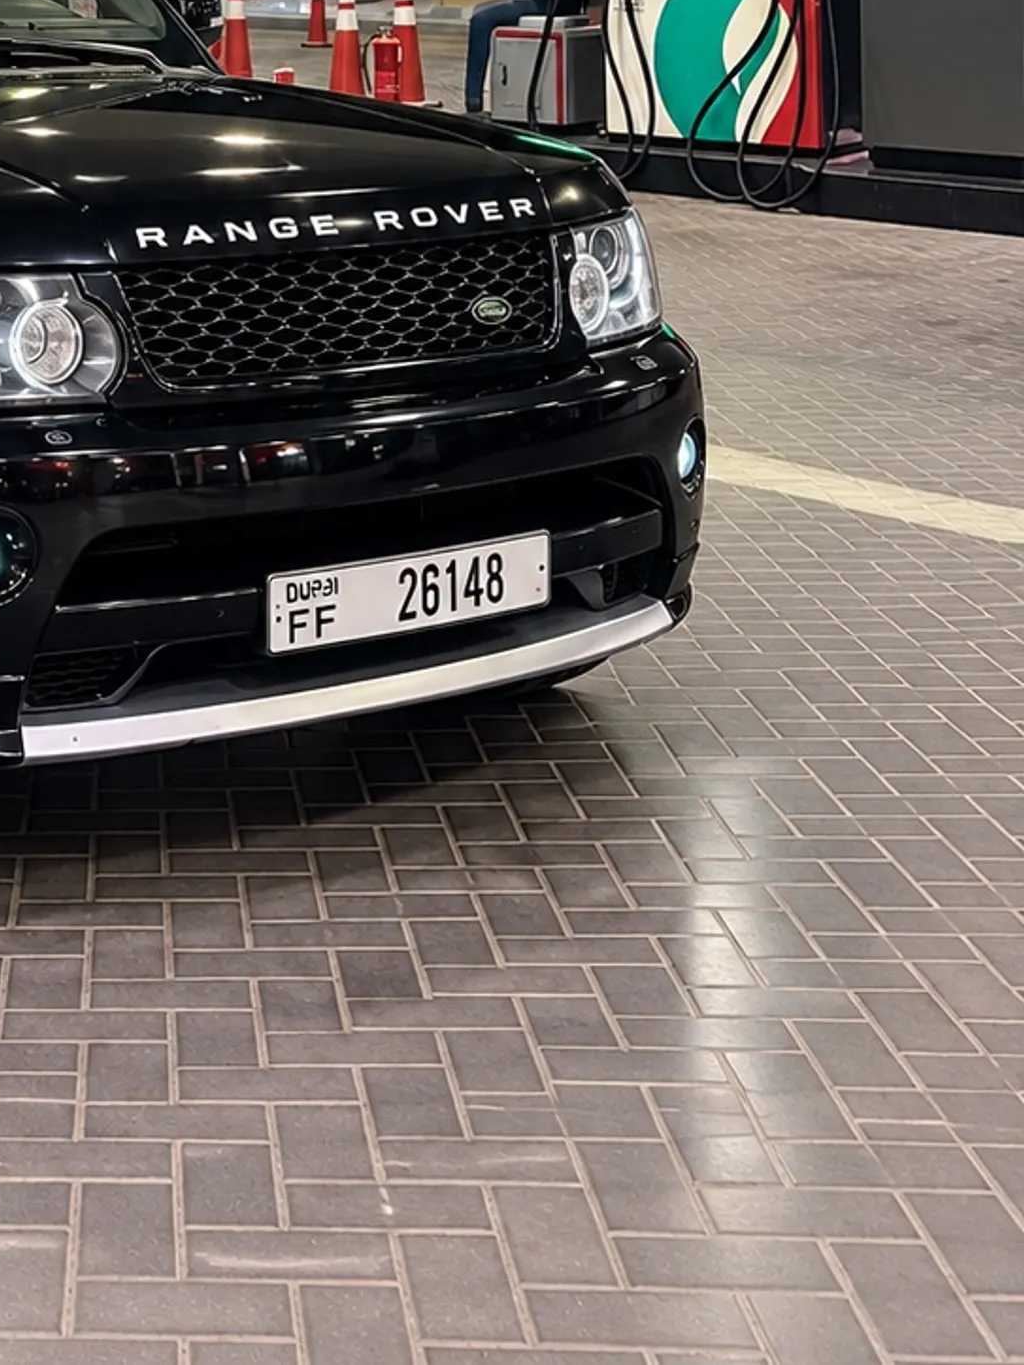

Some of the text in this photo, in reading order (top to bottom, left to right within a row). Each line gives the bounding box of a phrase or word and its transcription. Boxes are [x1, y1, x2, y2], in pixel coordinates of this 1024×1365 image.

[135, 196, 536, 249] RANGE ROVER
[397, 552, 504, 622] 26148
[288, 604, 337, 644] FF
